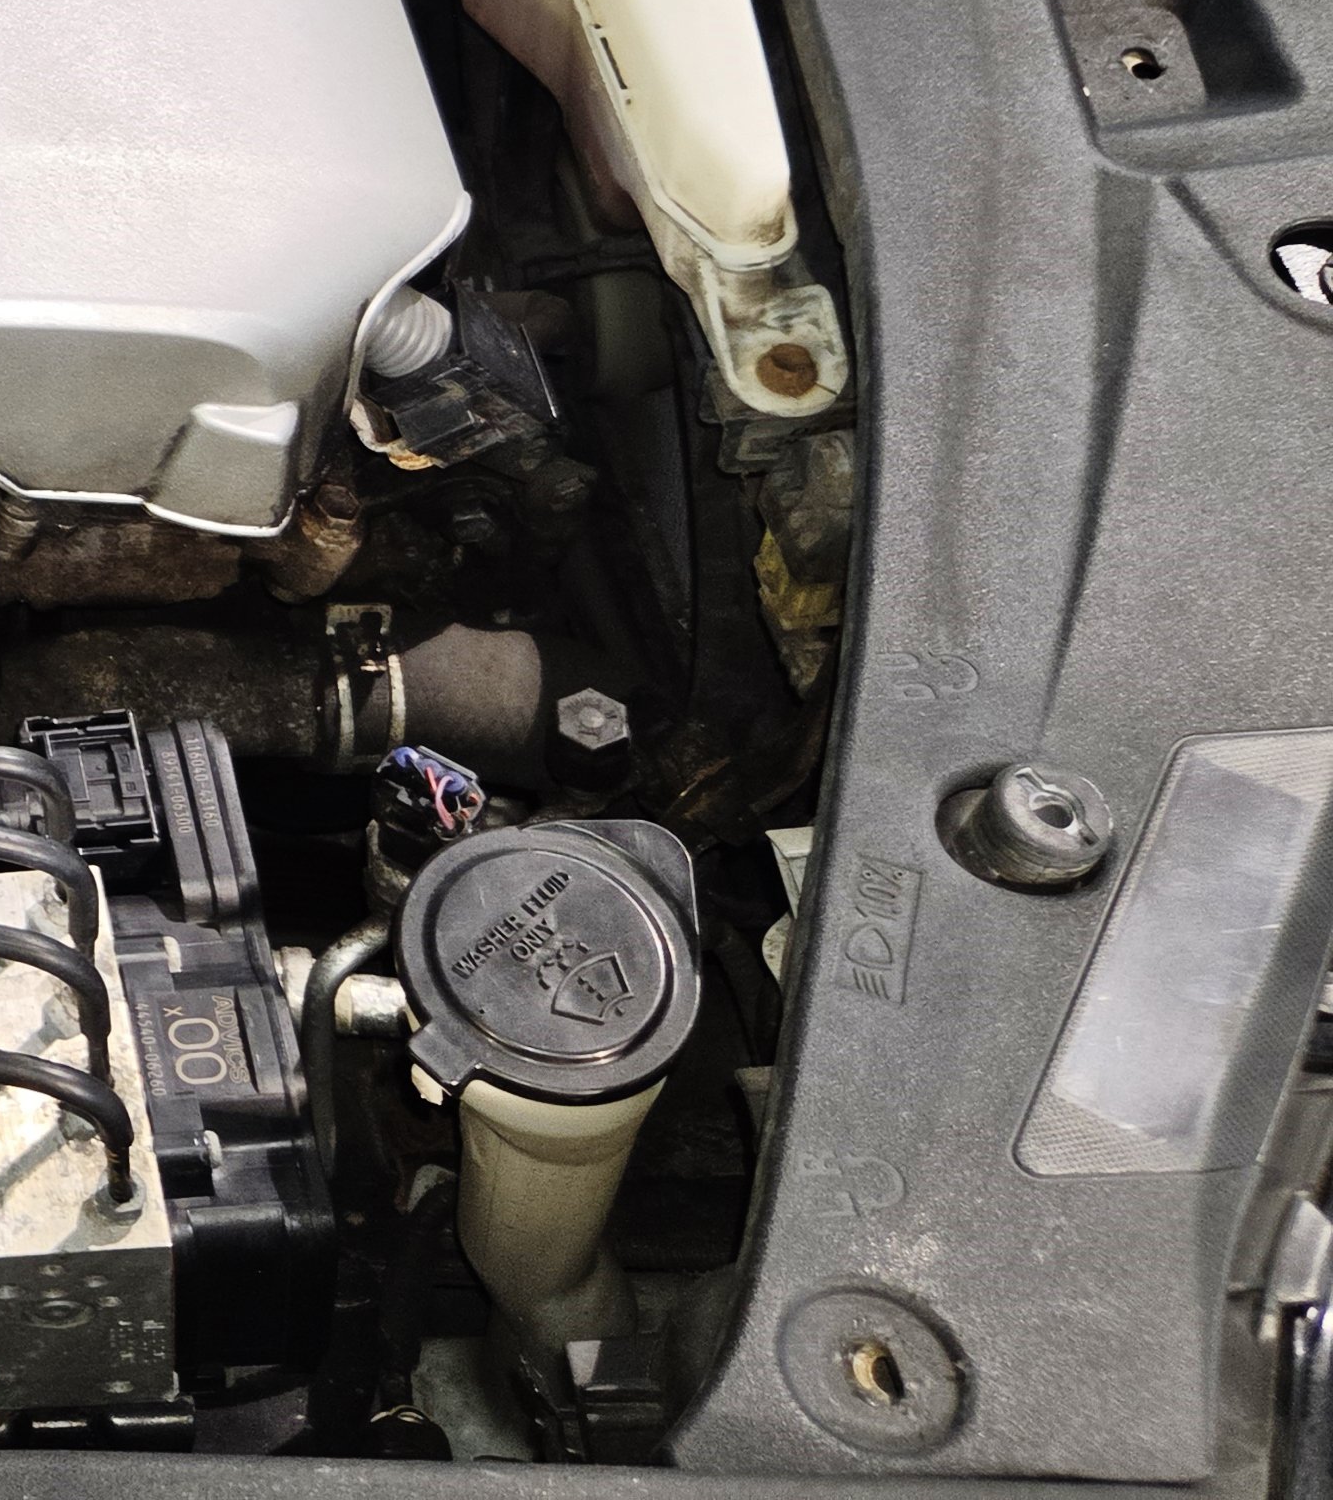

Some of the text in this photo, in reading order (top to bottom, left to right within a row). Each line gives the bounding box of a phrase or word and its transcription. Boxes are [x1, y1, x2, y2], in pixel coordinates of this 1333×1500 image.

[161, 751, 193, 834] 89541-06300
[185, 738, 219, 827] 116040-43160
[452, 872, 571, 979] WASHER FLUID
[134, 1003, 166, 1097] 44540-06260
[212, 995, 250, 1084] ADVICS
